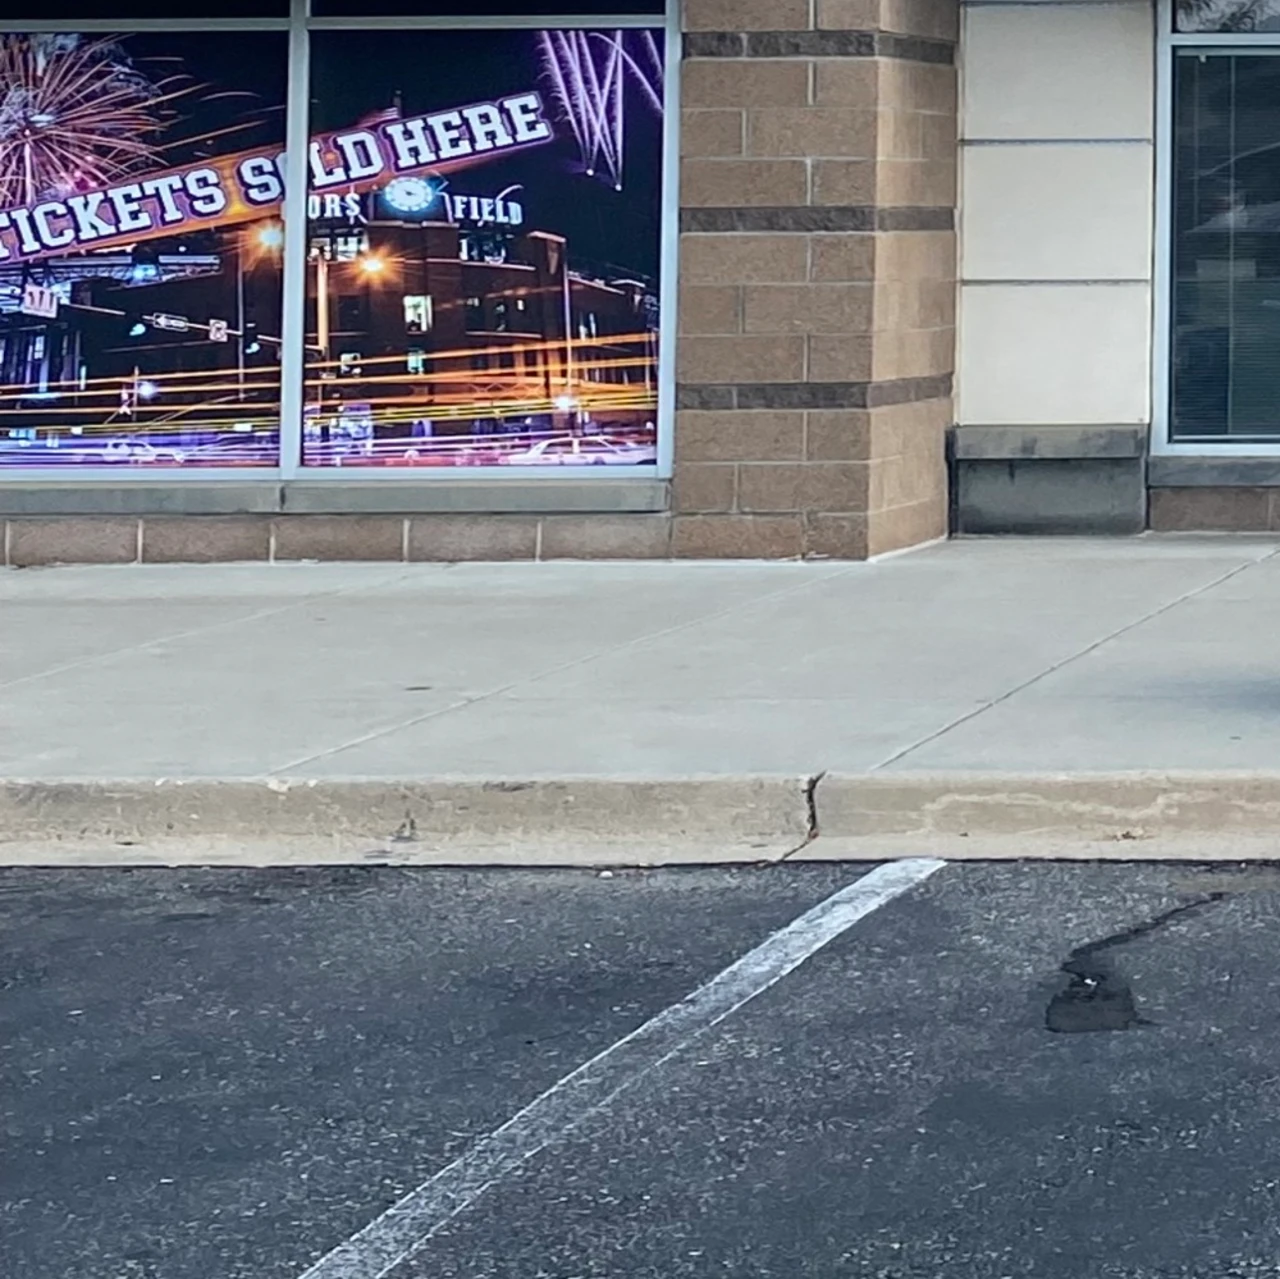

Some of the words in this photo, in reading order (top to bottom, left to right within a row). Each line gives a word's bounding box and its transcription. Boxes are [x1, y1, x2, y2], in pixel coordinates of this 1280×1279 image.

[0, 168, 226, 258] ICKETS
[240, 130, 385, 204] SLD
[387, 93, 550, 169] HERE
[452, 194, 524, 225] FIELD
